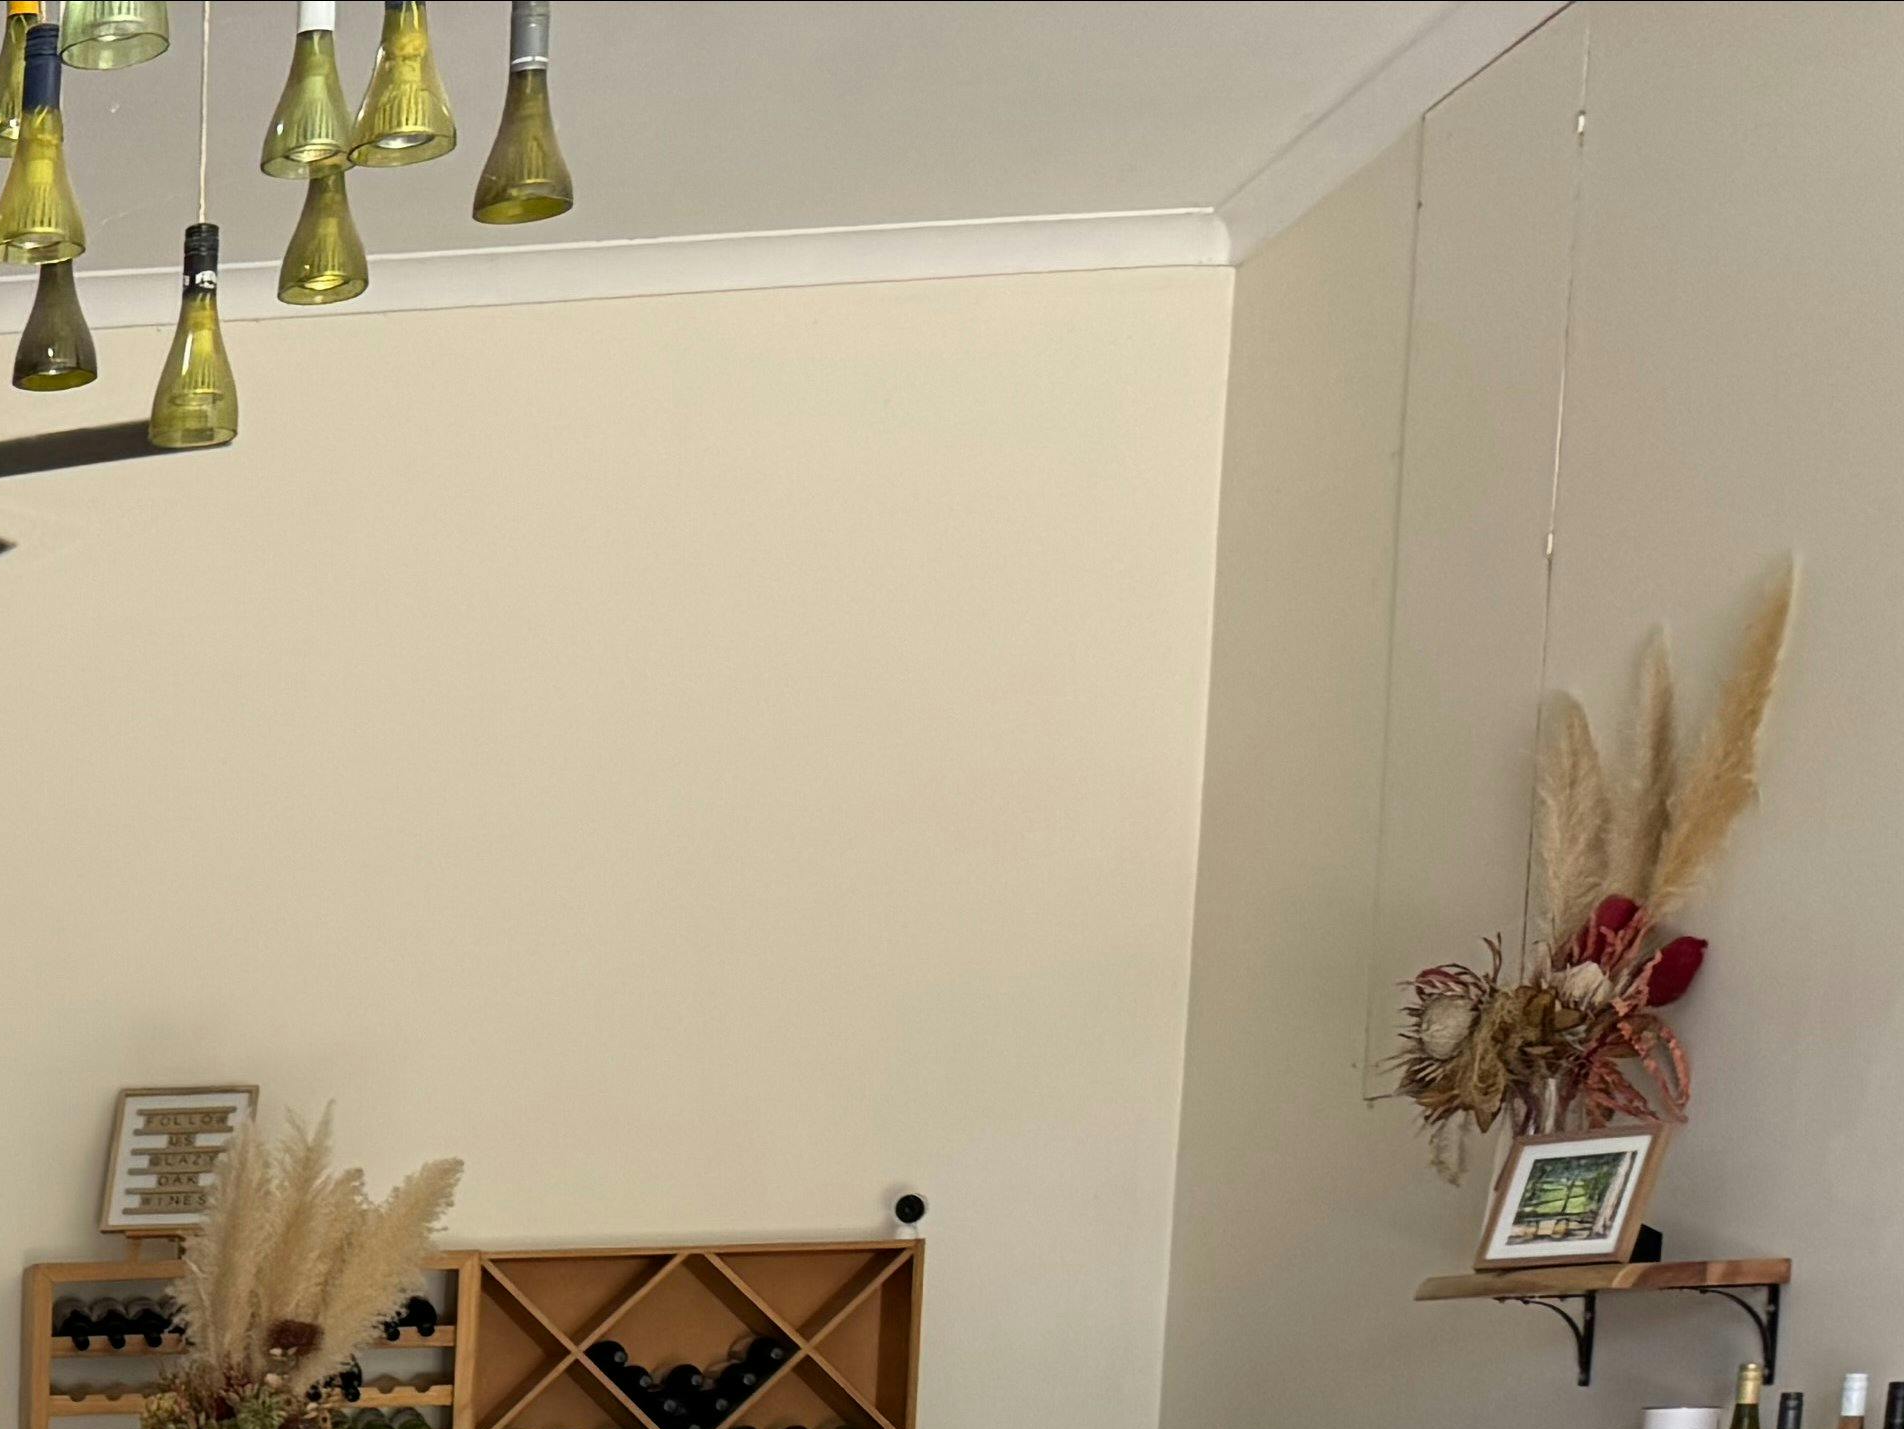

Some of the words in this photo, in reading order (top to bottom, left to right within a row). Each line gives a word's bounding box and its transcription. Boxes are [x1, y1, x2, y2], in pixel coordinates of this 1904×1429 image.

[145, 1114, 228, 1126] FOLLOW
[168, 1134, 193, 1146] US
[158, 1173, 197, 1186] OAK
